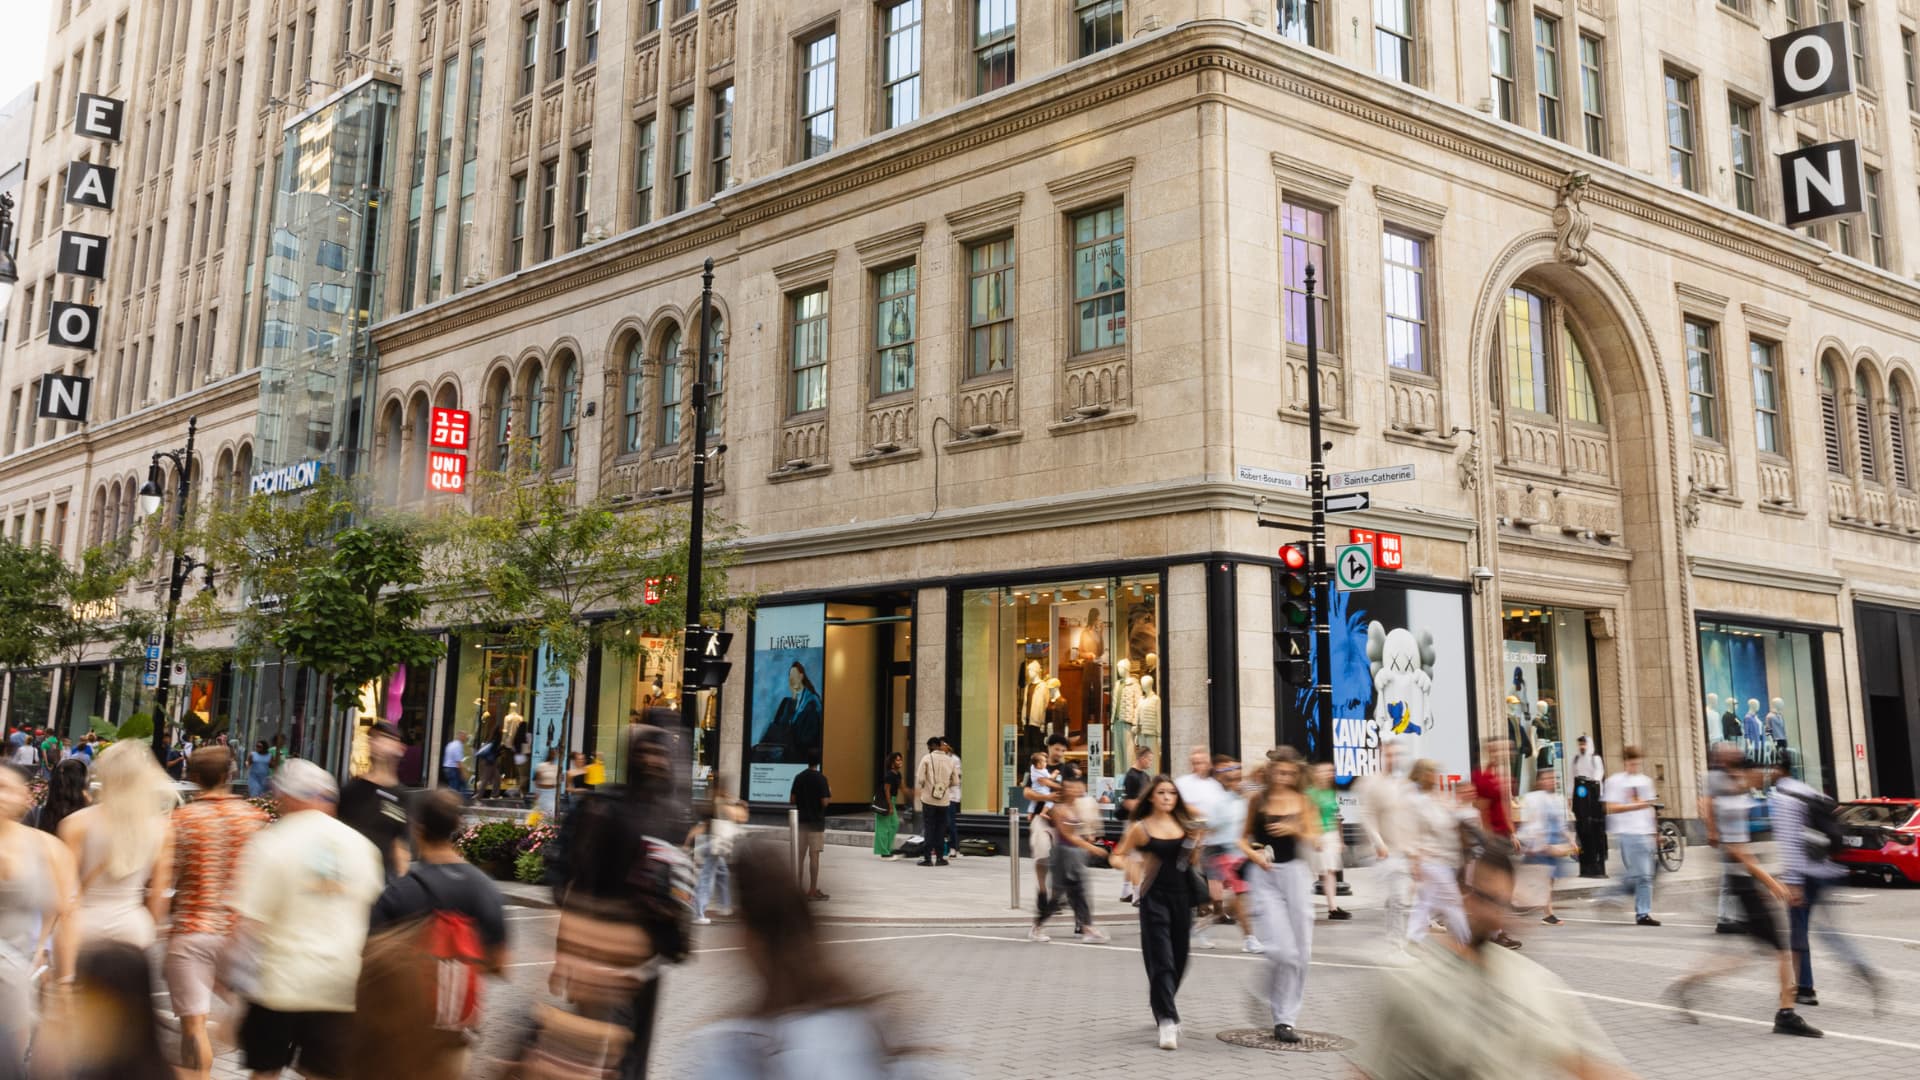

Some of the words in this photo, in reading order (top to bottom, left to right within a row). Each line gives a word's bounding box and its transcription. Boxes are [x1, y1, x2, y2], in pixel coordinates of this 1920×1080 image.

[48, 98, 113, 416] EATON
[432, 455, 461, 473] UNI
[431, 472, 462, 490] QLO
[1240, 470, 1292, 486] Robert-Bourassa
[1343, 472, 1411, 486] Sainte-Catherine
[770, 634, 810, 651] LifeWear
[1332, 718, 1379, 748] KAWS
